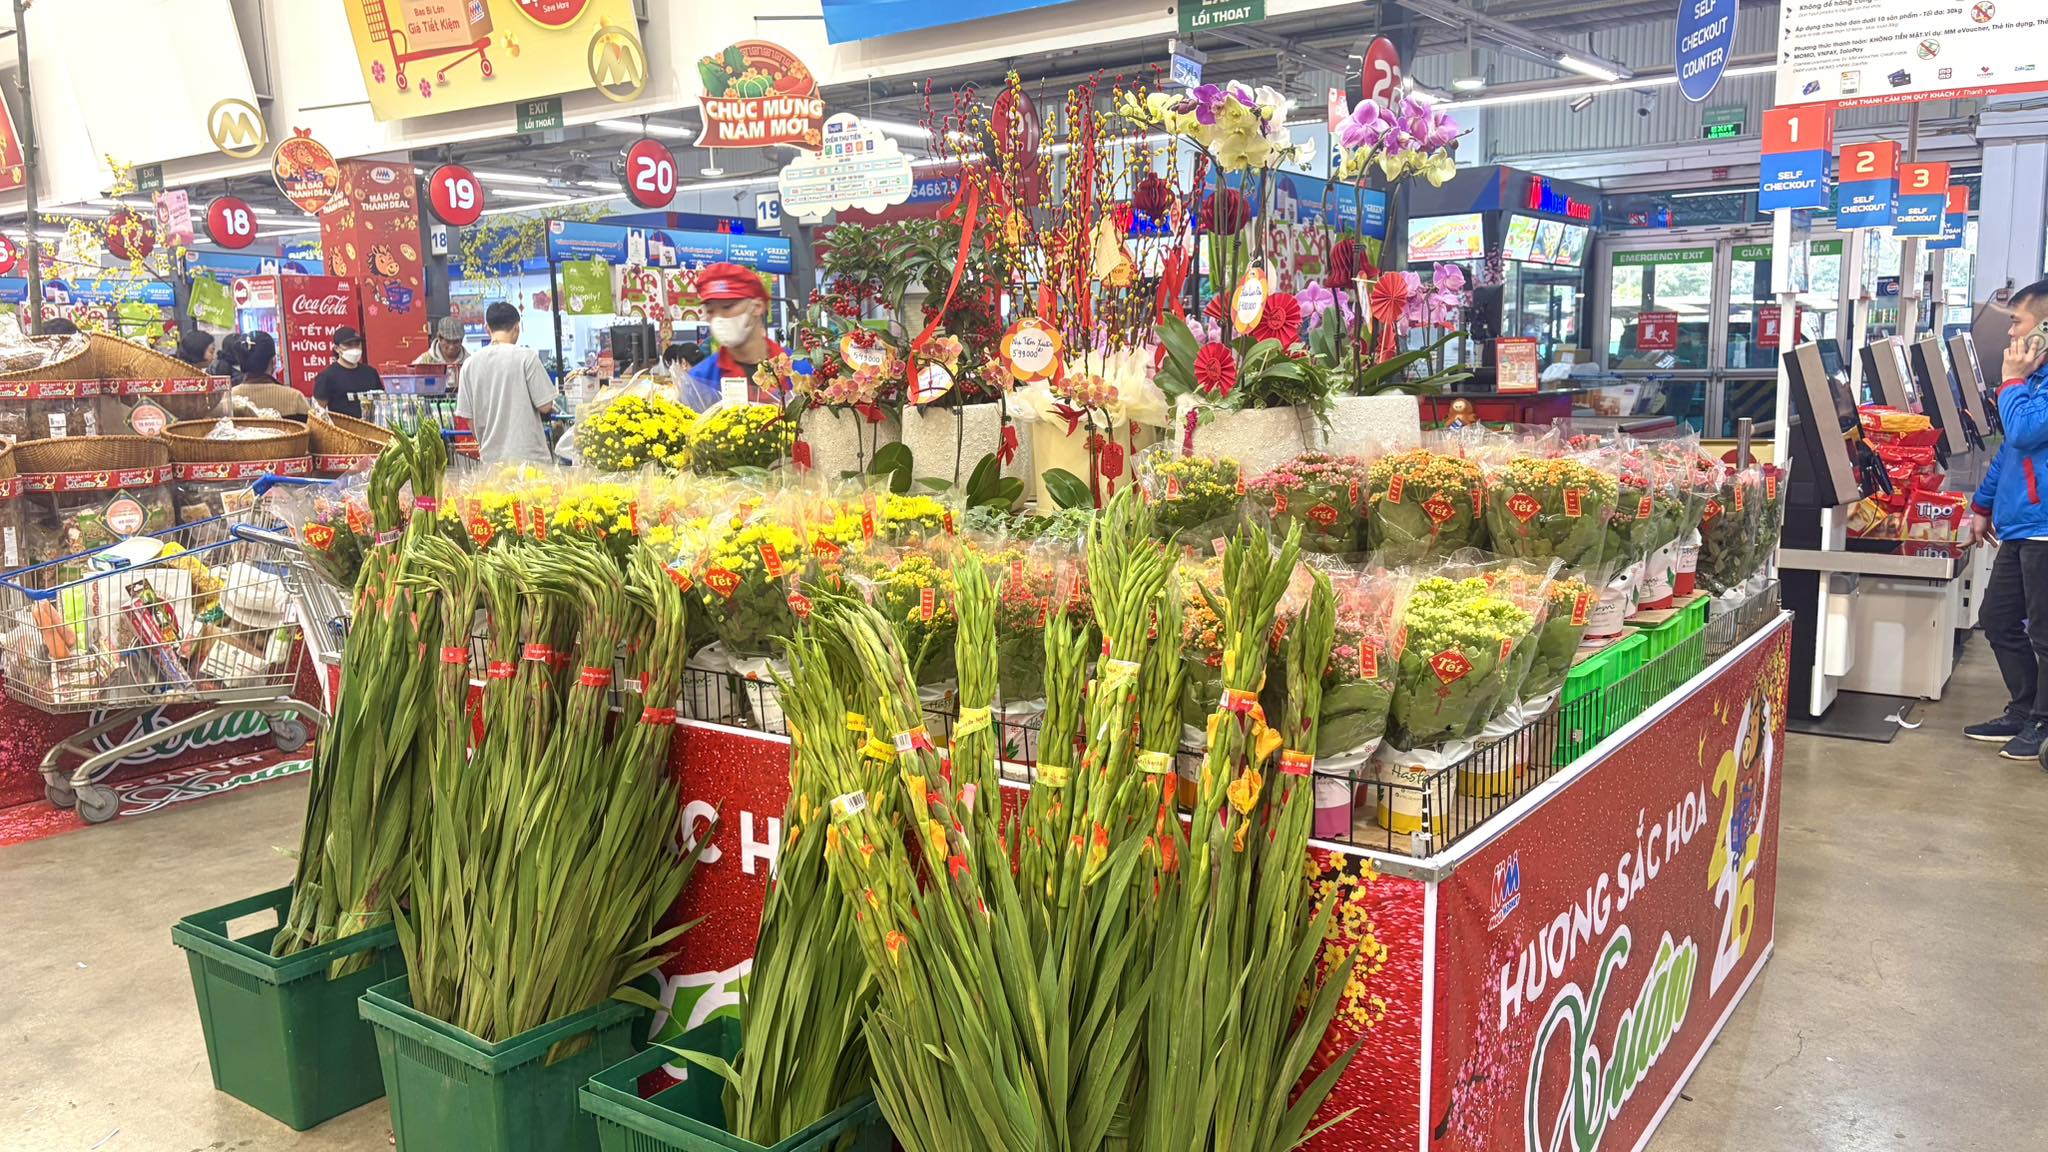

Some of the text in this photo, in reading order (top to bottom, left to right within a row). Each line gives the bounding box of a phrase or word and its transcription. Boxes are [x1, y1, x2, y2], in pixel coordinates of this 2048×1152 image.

[414, 7, 427, 17] Bao
[543, 1, 570, 13] Save More
[1694, 0, 1717, 19] SELF
[408, 17, 461, 34] Giá Tiết Kiệm
[1681, 16, 1728, 53] CHECKOUT
[1869, 34, 1893, 43] KHÔNG
[1682, 47, 1723, 79] COUNTER
[1929, 90, 1955, 99] KHÁCH
[1984, 88, 1997, 97] you
[529, 100, 549, 114] EXIT
[706, 96, 823, 119] CHÚC MỪNG
[719, 115, 809, 140] NĂM MỚI
[1787, 116, 1799, 142] 1
[1855, 150, 1875, 173] 2
[636, 156, 674, 194] 20
[1777, 170, 1803, 180] SELF
[1912, 168, 1930, 188] 3
[314, 188, 333, 197] DEAL
[1763, 179, 1816, 192] CHECKOUT
[444, 178, 476, 210] 19
[1852, 195, 1875, 204] SELF
[389, 199, 410, 209] DEAL
[758, 201, 780, 221] 19
[1567, 197, 1592, 221] Corner
[1840, 203, 1886, 213] CHECKOUT
[1908, 207, 1927, 215] SELF
[223, 208, 250, 236] 18
[1897, 214, 1937, 223] CHECKOUT
[432, 232, 447, 248] 18
[1620, 250, 1705, 263] EMERGENCY EXIT
[299, 323, 322, 336] TẾT
[291, 339, 327, 351] HỨNG
[303, 353, 326, 366] LÊN
[1429, 503, 1450, 517] Tết
[1512, 499, 1534, 513] Tết
[1916, 502, 1953, 520] Tipo
[310, 527, 329, 543] Tết
[472, 522, 489, 536] Tết
[816, 545, 834, 560] Tết
[711, 572, 732, 587] Tết
[1438, 657, 1464, 673] Tết
[1500, 780, 1708, 1032] HƯƠNG SẮC HOA
[1524, 924, 1698, 1152] Xuân
